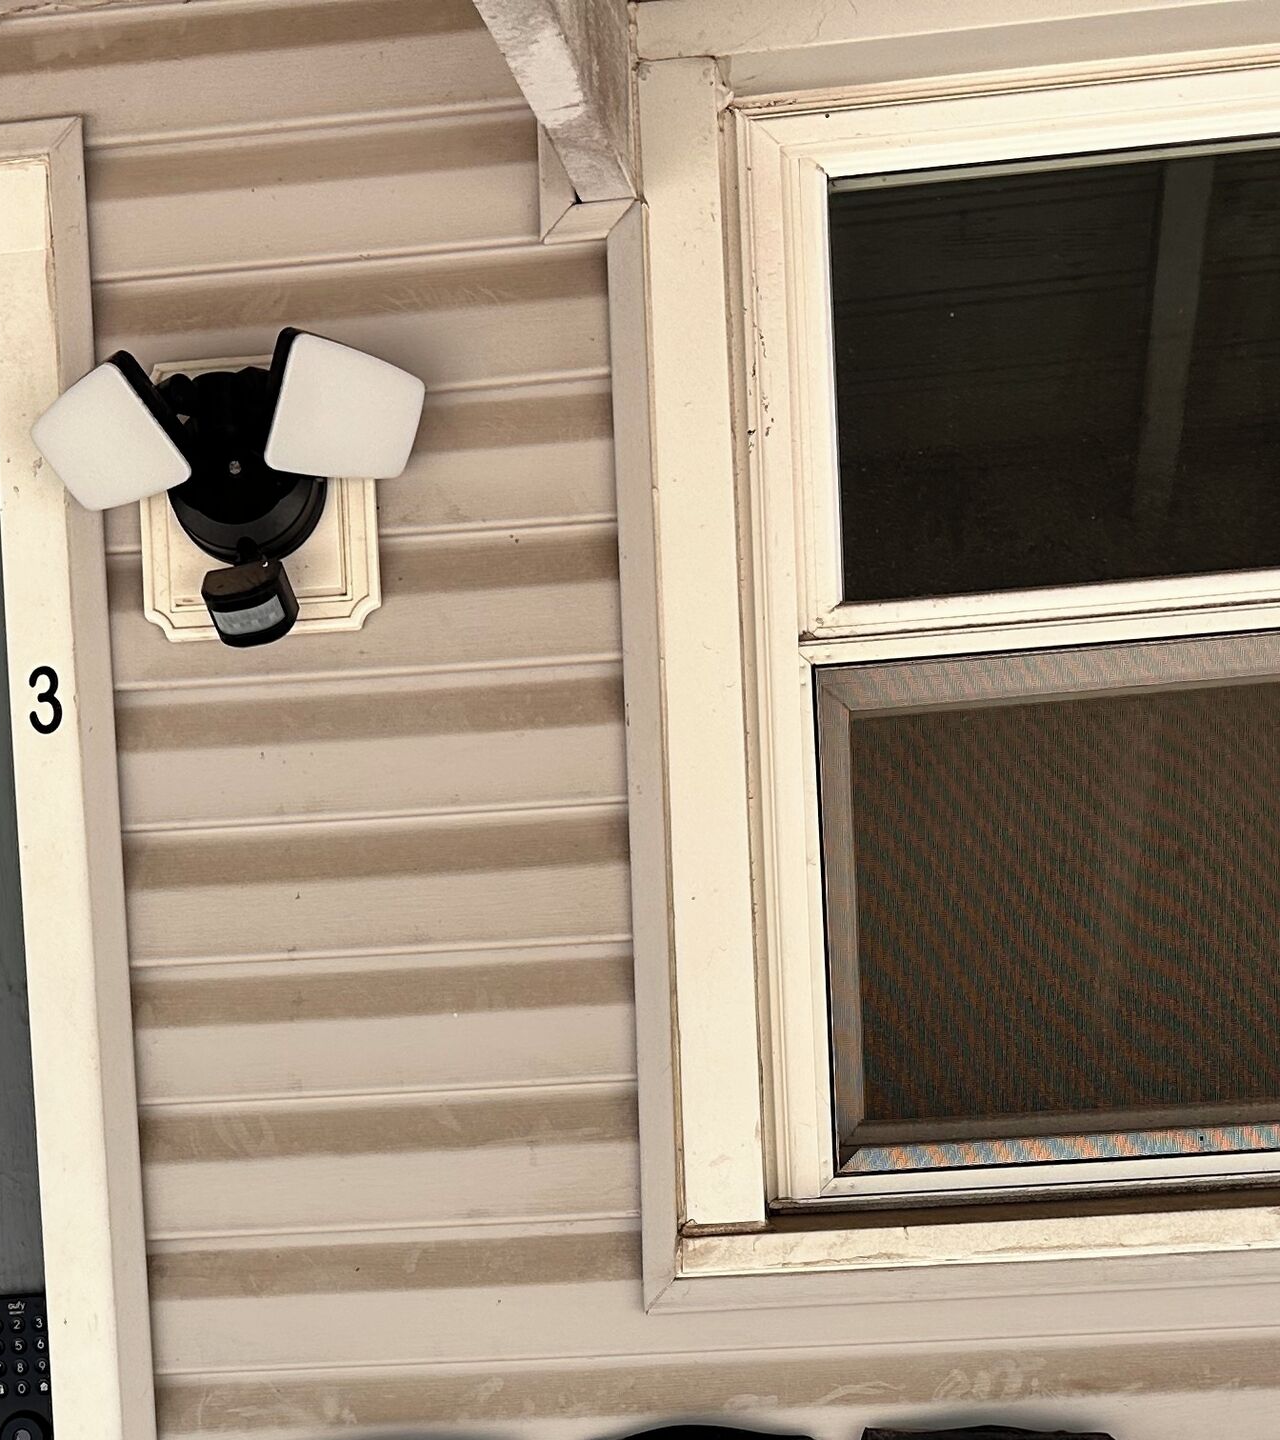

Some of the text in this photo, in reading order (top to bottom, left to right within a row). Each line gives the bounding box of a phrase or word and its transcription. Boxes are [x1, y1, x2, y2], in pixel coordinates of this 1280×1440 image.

[28, 665, 63, 735] 3
[13, 1319, 21, 1330] 2
[35, 1317, 43, 1329] 3
[14, 1340, 23, 1351] 5
[37, 1338, 45, 1350] 6
[17, 1362, 24, 1373] 8
[38, 1360, 46, 1371] 9
[17, 1383, 26, 1394] 0
